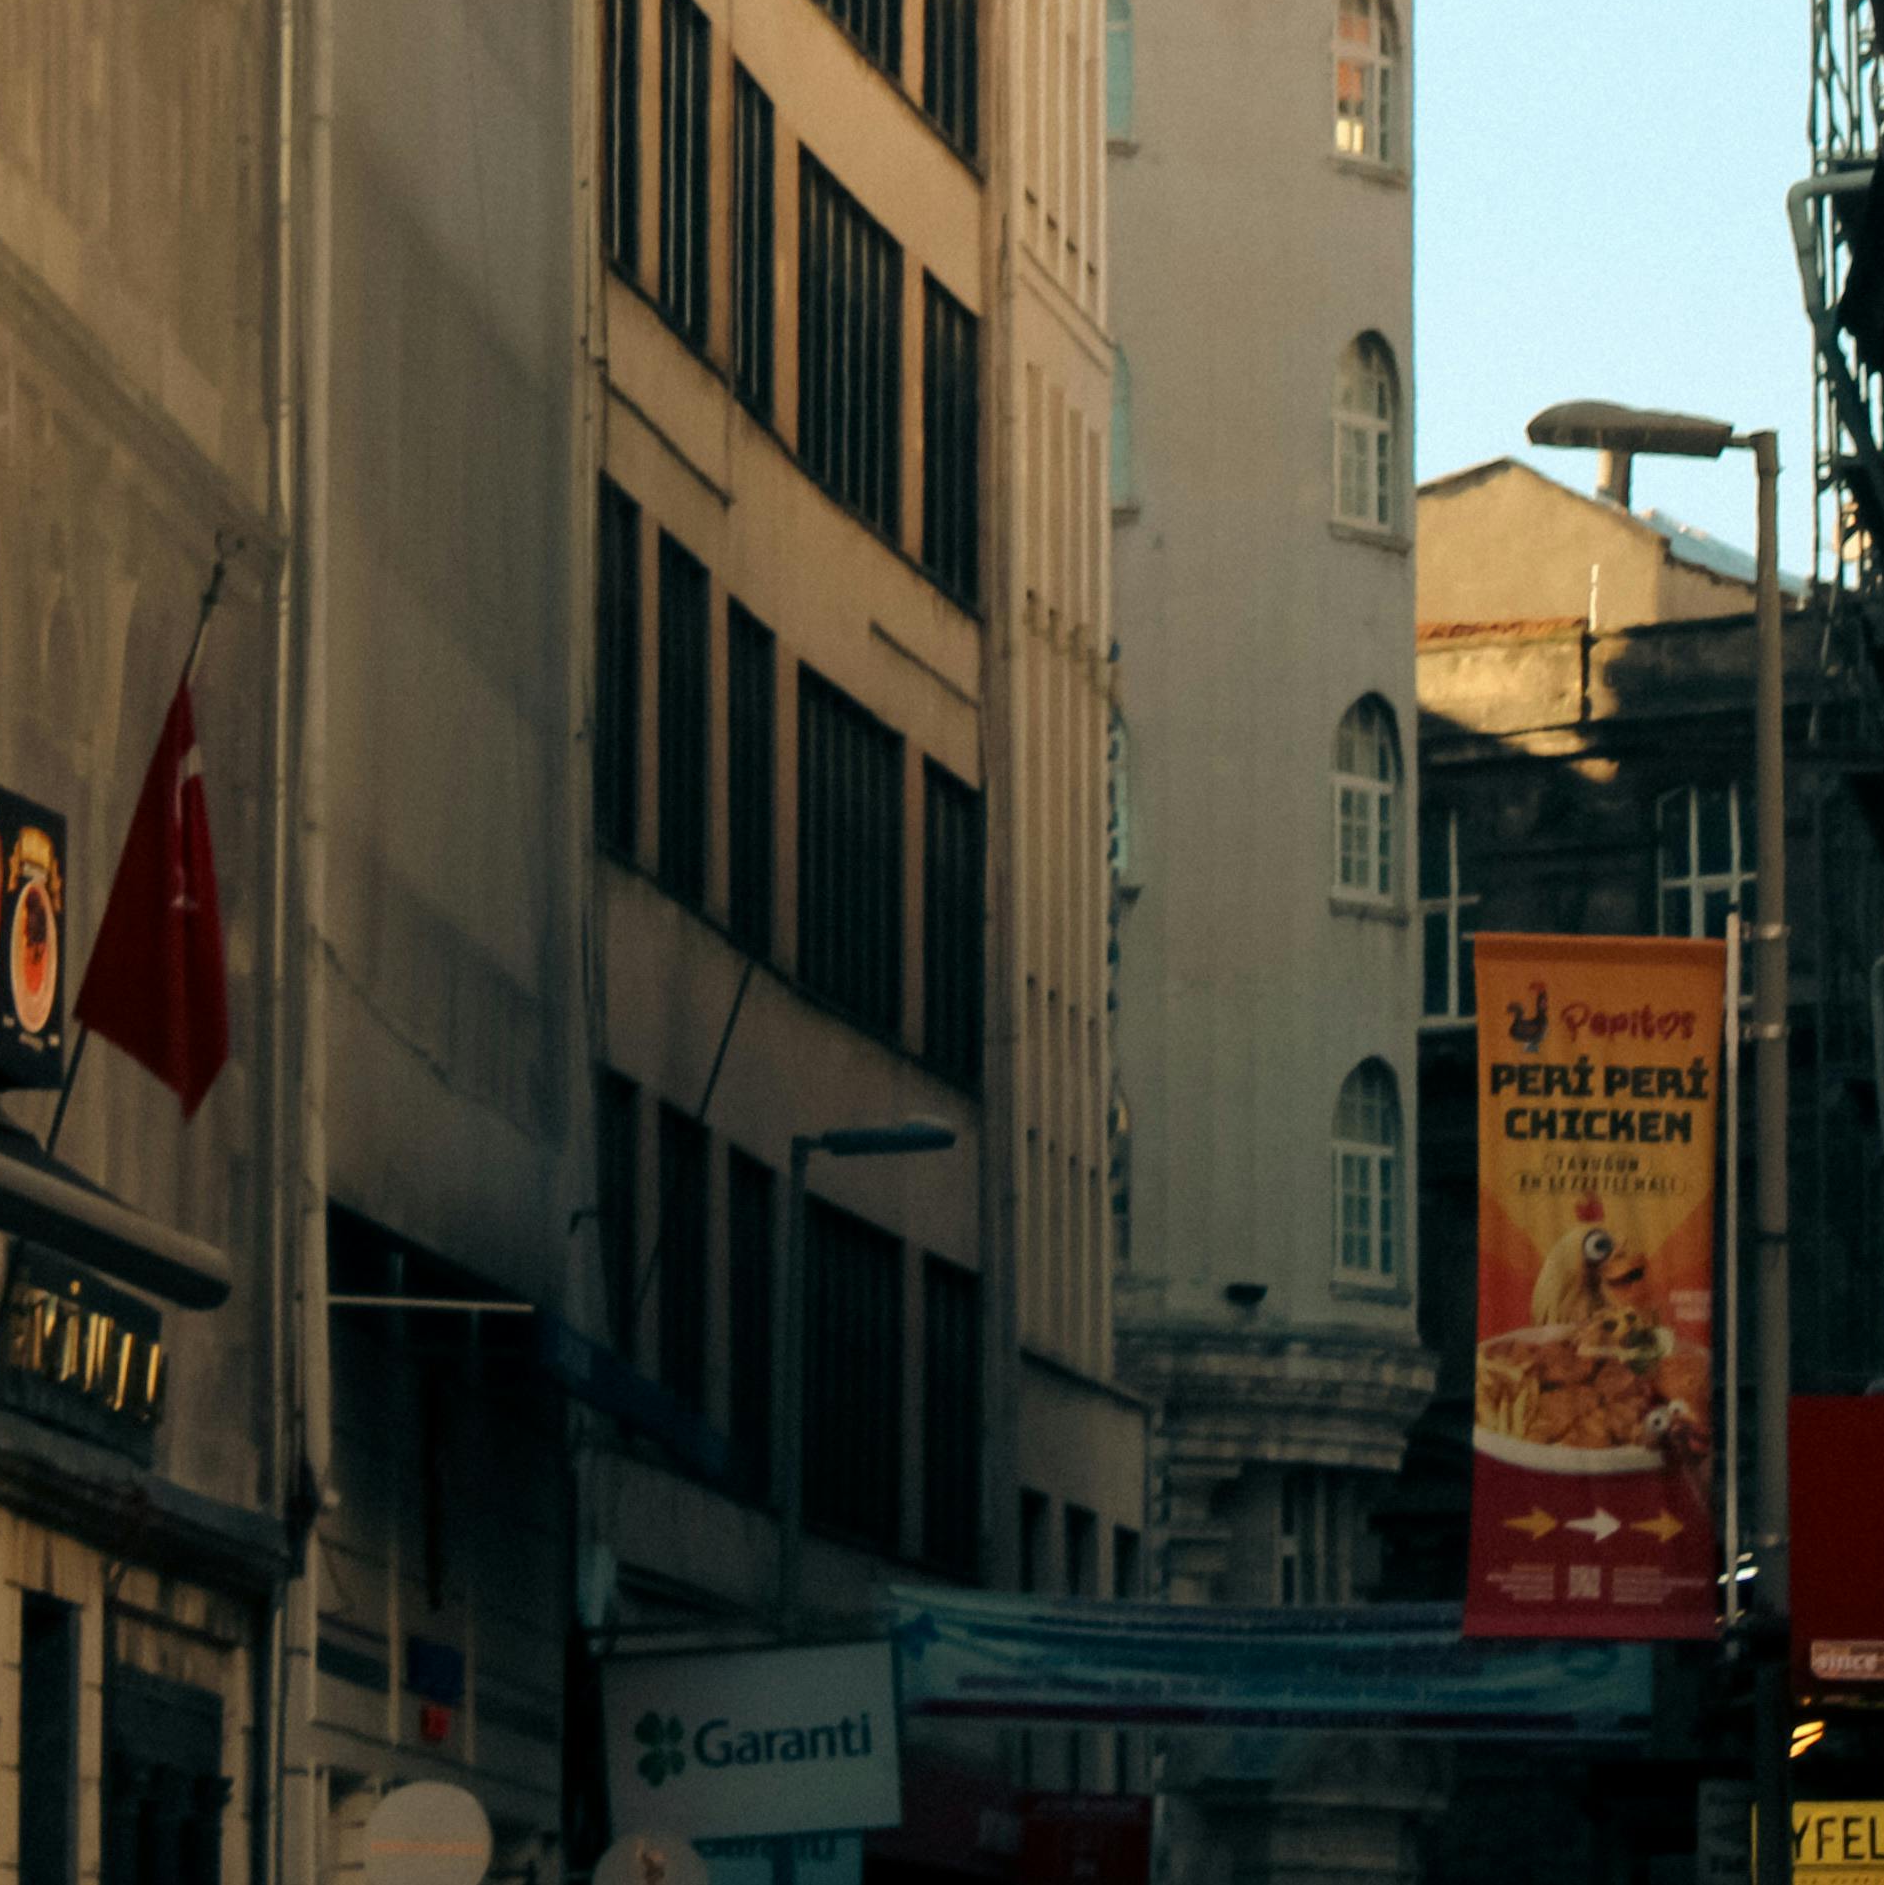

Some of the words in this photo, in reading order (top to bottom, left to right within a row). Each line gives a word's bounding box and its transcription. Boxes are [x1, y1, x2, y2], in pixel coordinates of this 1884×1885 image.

[1490, 1055, 1594, 1098] PERİ
[1604, 1057, 1710, 1100] PERİ
[1504, 1108, 1693, 1143] CHICKEN
[693, 1711, 873, 1769] Garanti
